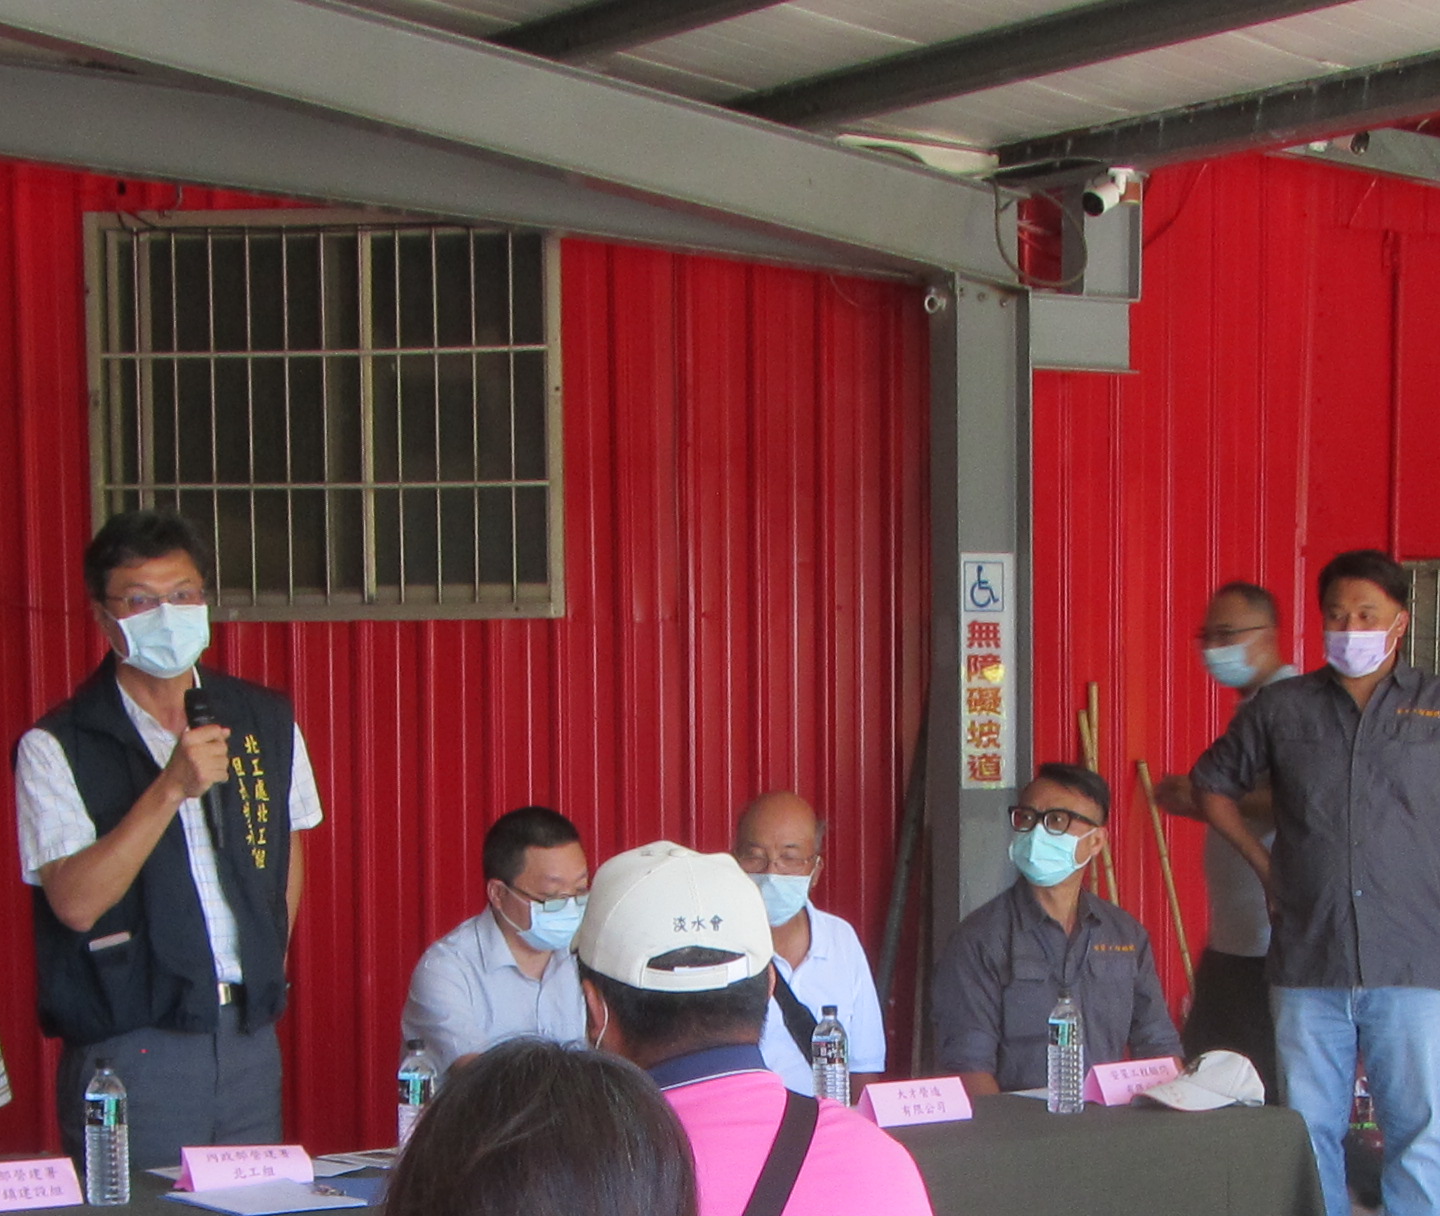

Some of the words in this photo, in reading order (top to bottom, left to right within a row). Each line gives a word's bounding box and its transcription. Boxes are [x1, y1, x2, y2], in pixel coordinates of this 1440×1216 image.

[967, 620, 1002, 782] 無障礙坡道
[672, 913, 724, 933] 淡水會
[234, 1165, 276, 1179] 北工組
